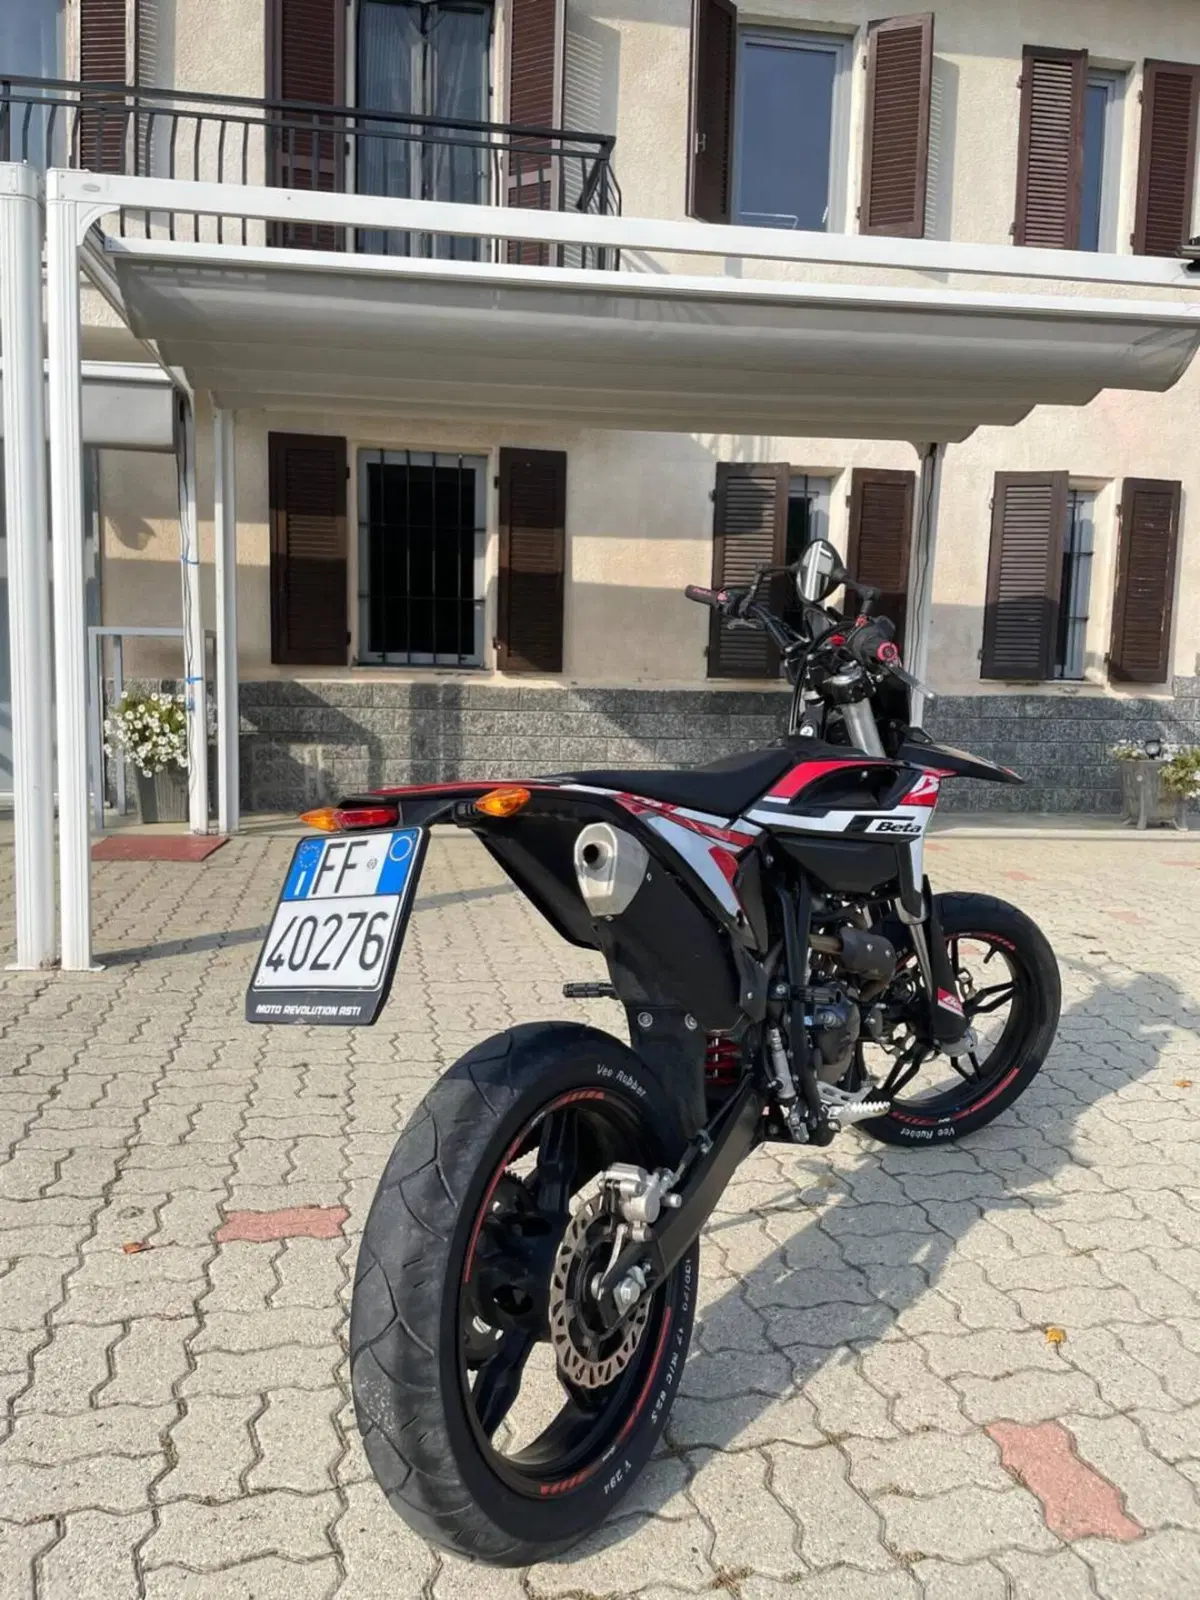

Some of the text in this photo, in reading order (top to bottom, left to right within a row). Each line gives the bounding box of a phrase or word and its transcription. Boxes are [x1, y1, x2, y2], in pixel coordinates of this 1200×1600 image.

[876, 821, 922, 833] Beta
[311, 840, 369, 895] FF
[294, 871, 306, 896] I
[265, 911, 389, 973] 40276
[255, 1004, 361, 1016] MOTO REVOLUTION ASTI
[597, 1064, 647, 1098] Vee Rubber
[900, 1127, 955, 1139] Vee Rubber
